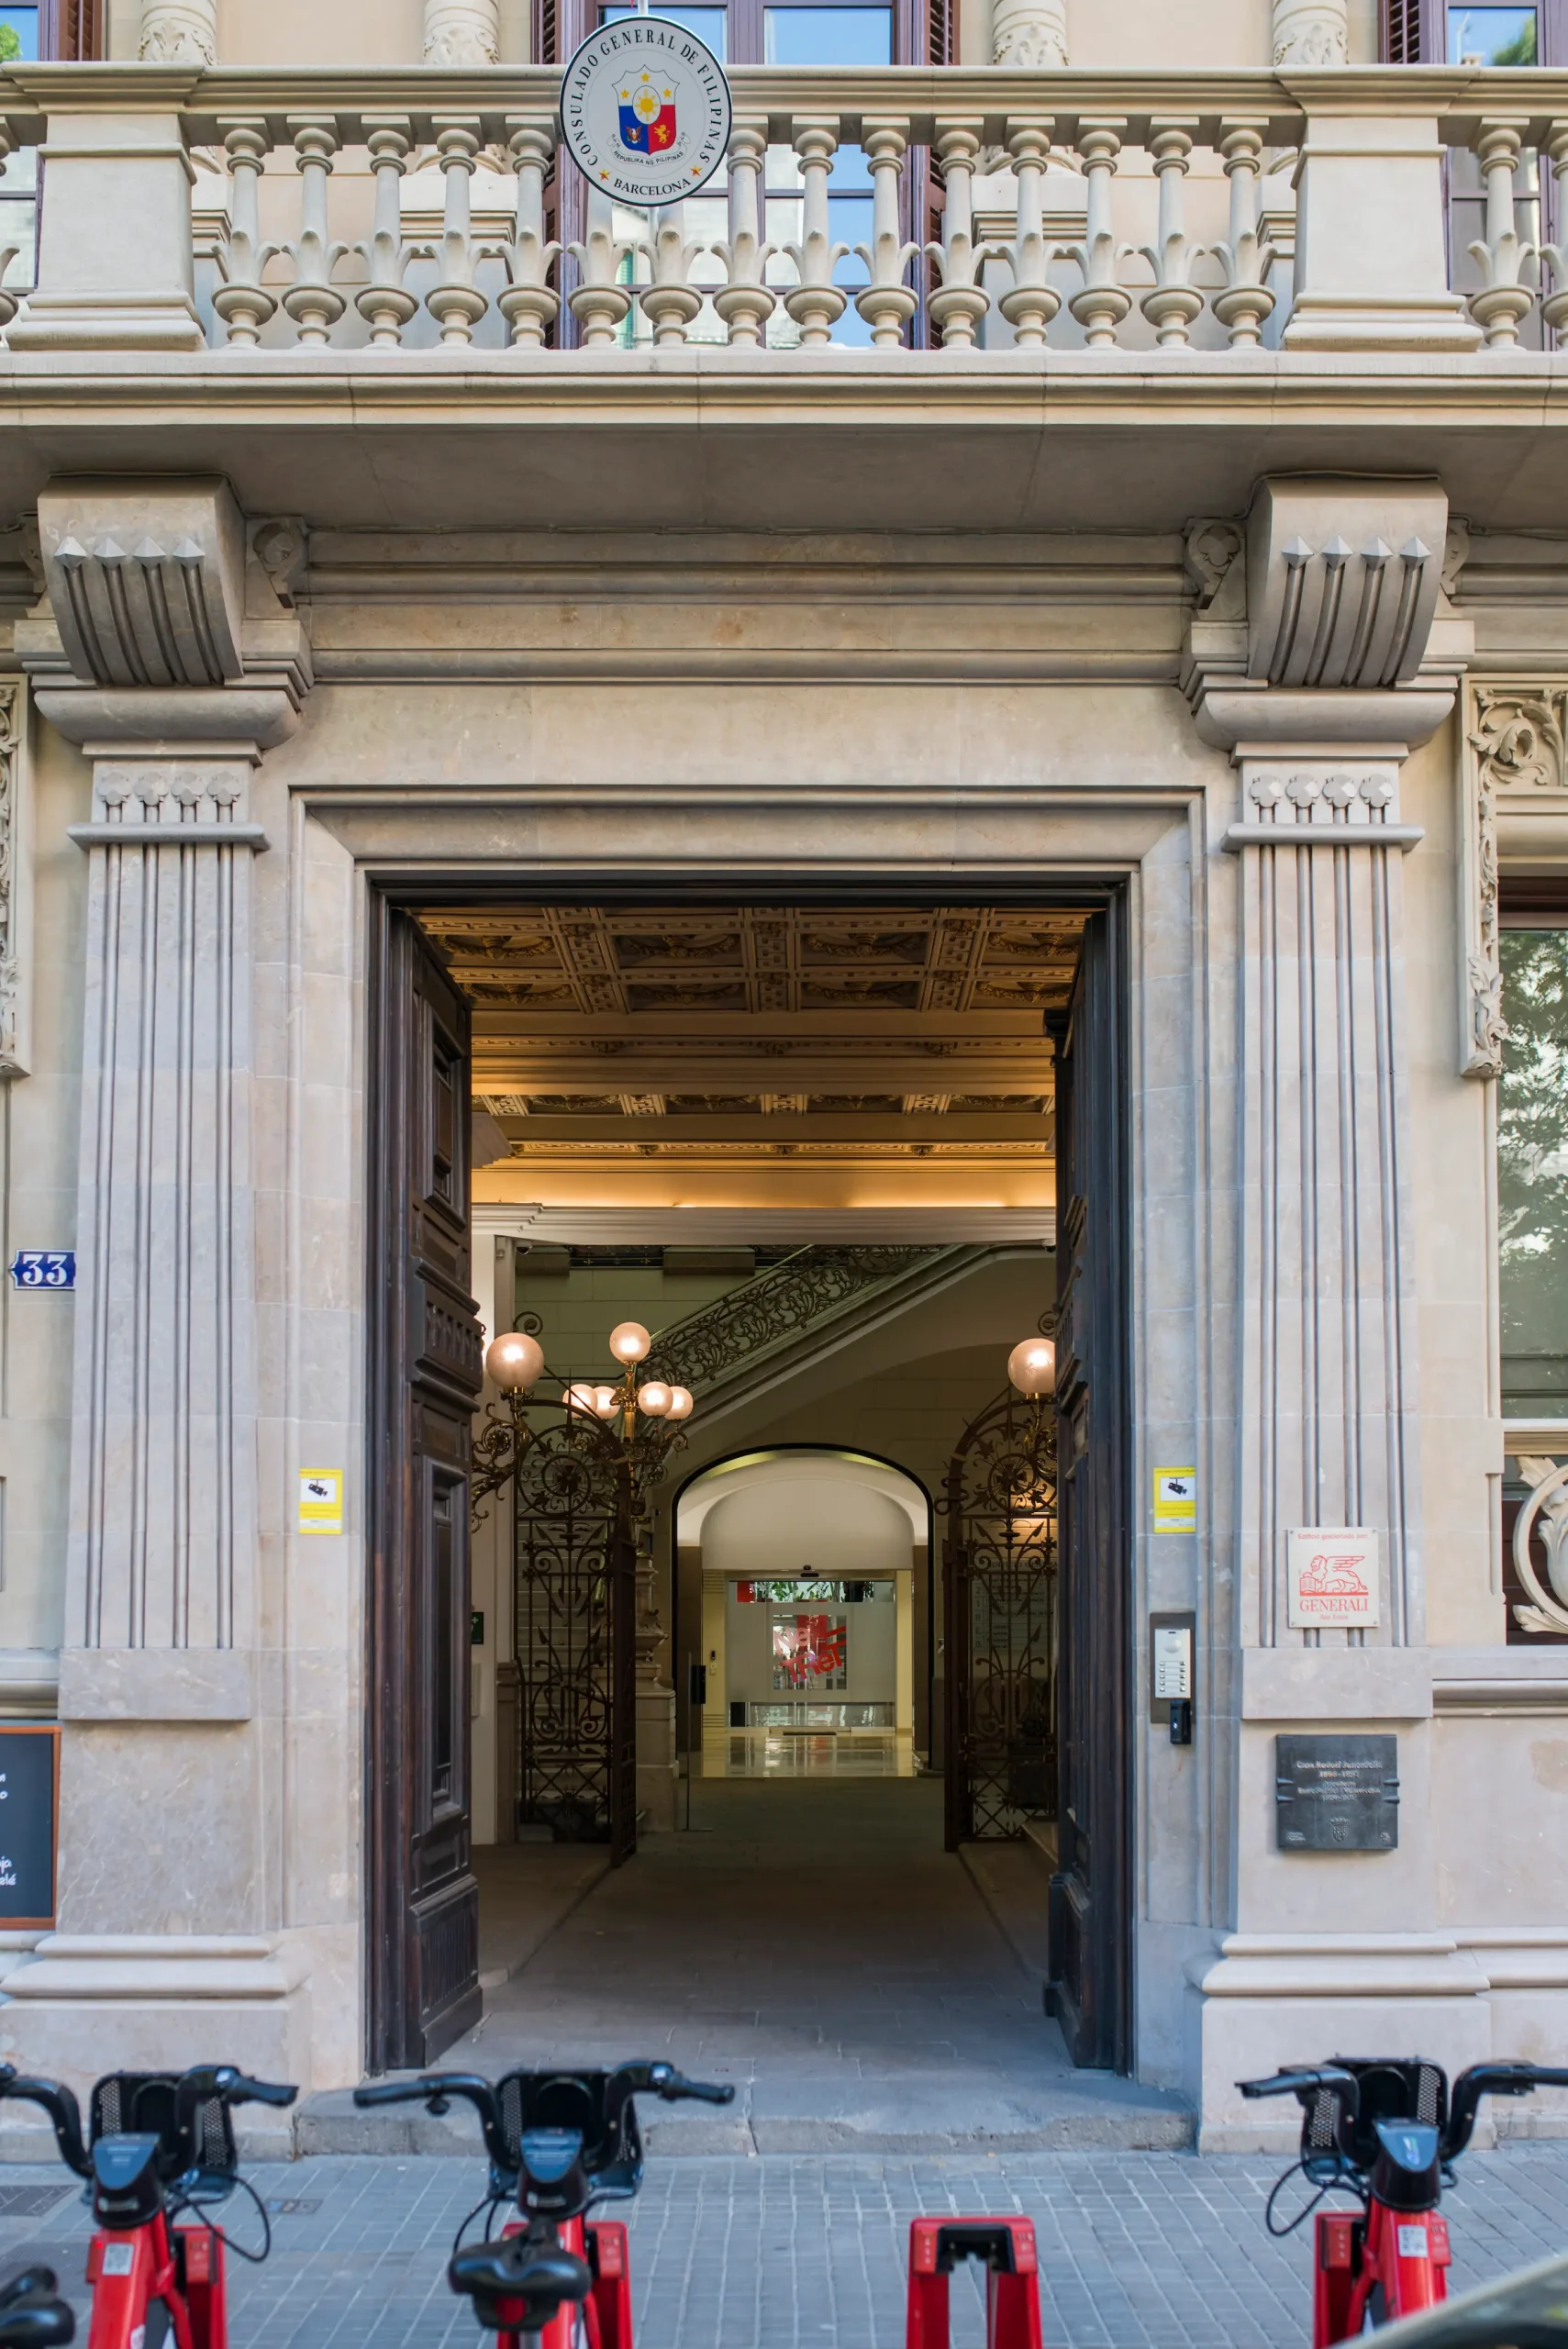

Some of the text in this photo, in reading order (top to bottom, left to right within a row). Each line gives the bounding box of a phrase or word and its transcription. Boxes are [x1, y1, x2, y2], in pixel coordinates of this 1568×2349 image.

[570, 28, 723, 167] CONSULADO GENERAL DE FILIPINAS
[613, 150, 644, 164] REPUBLIKA
[656, 150, 684, 163] PILIPINAS
[613, 177, 692, 196] BARCELONA
[22, 1253, 68, 1286] 33
[1299, 1598, 1369, 1612] GENERALI
